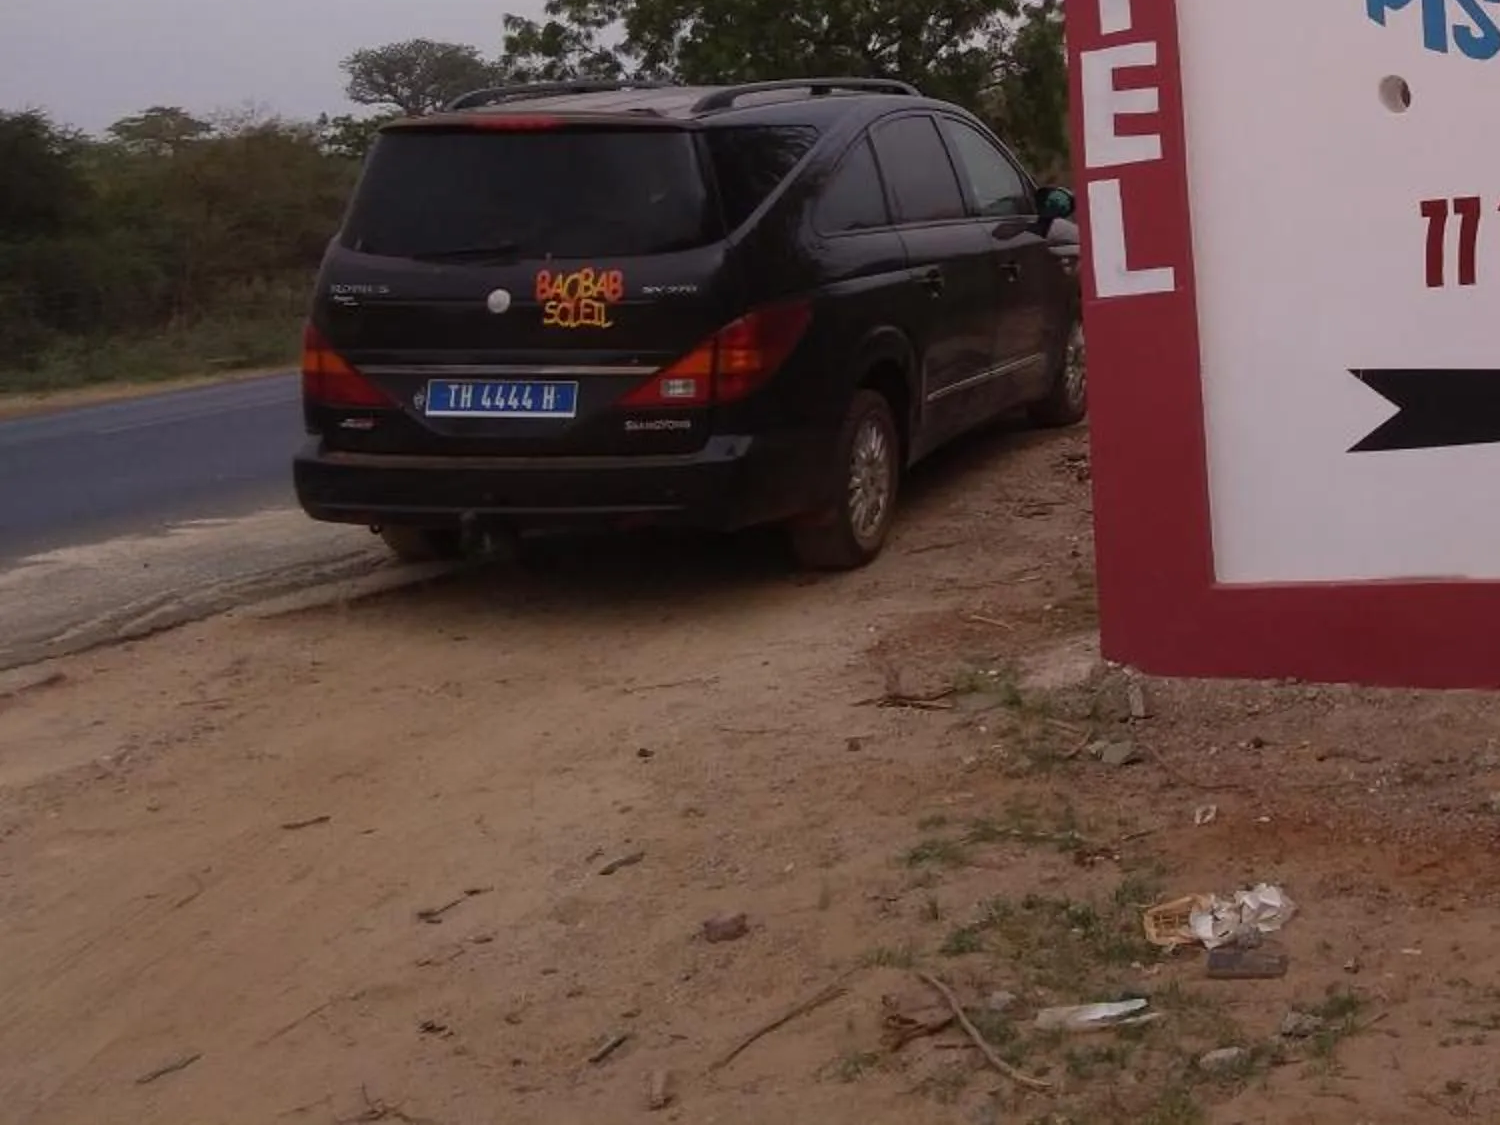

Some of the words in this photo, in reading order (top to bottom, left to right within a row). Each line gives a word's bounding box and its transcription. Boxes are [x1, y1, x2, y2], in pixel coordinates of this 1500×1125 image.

[1420, 198, 1481, 288] 77
[536, 267, 623, 302] BAOBAB
[543, 299, 613, 328] SOLEIL
[448, 384, 473, 408] TH
[481, 385, 532, 409] 4444
[542, 385, 556, 410] H
